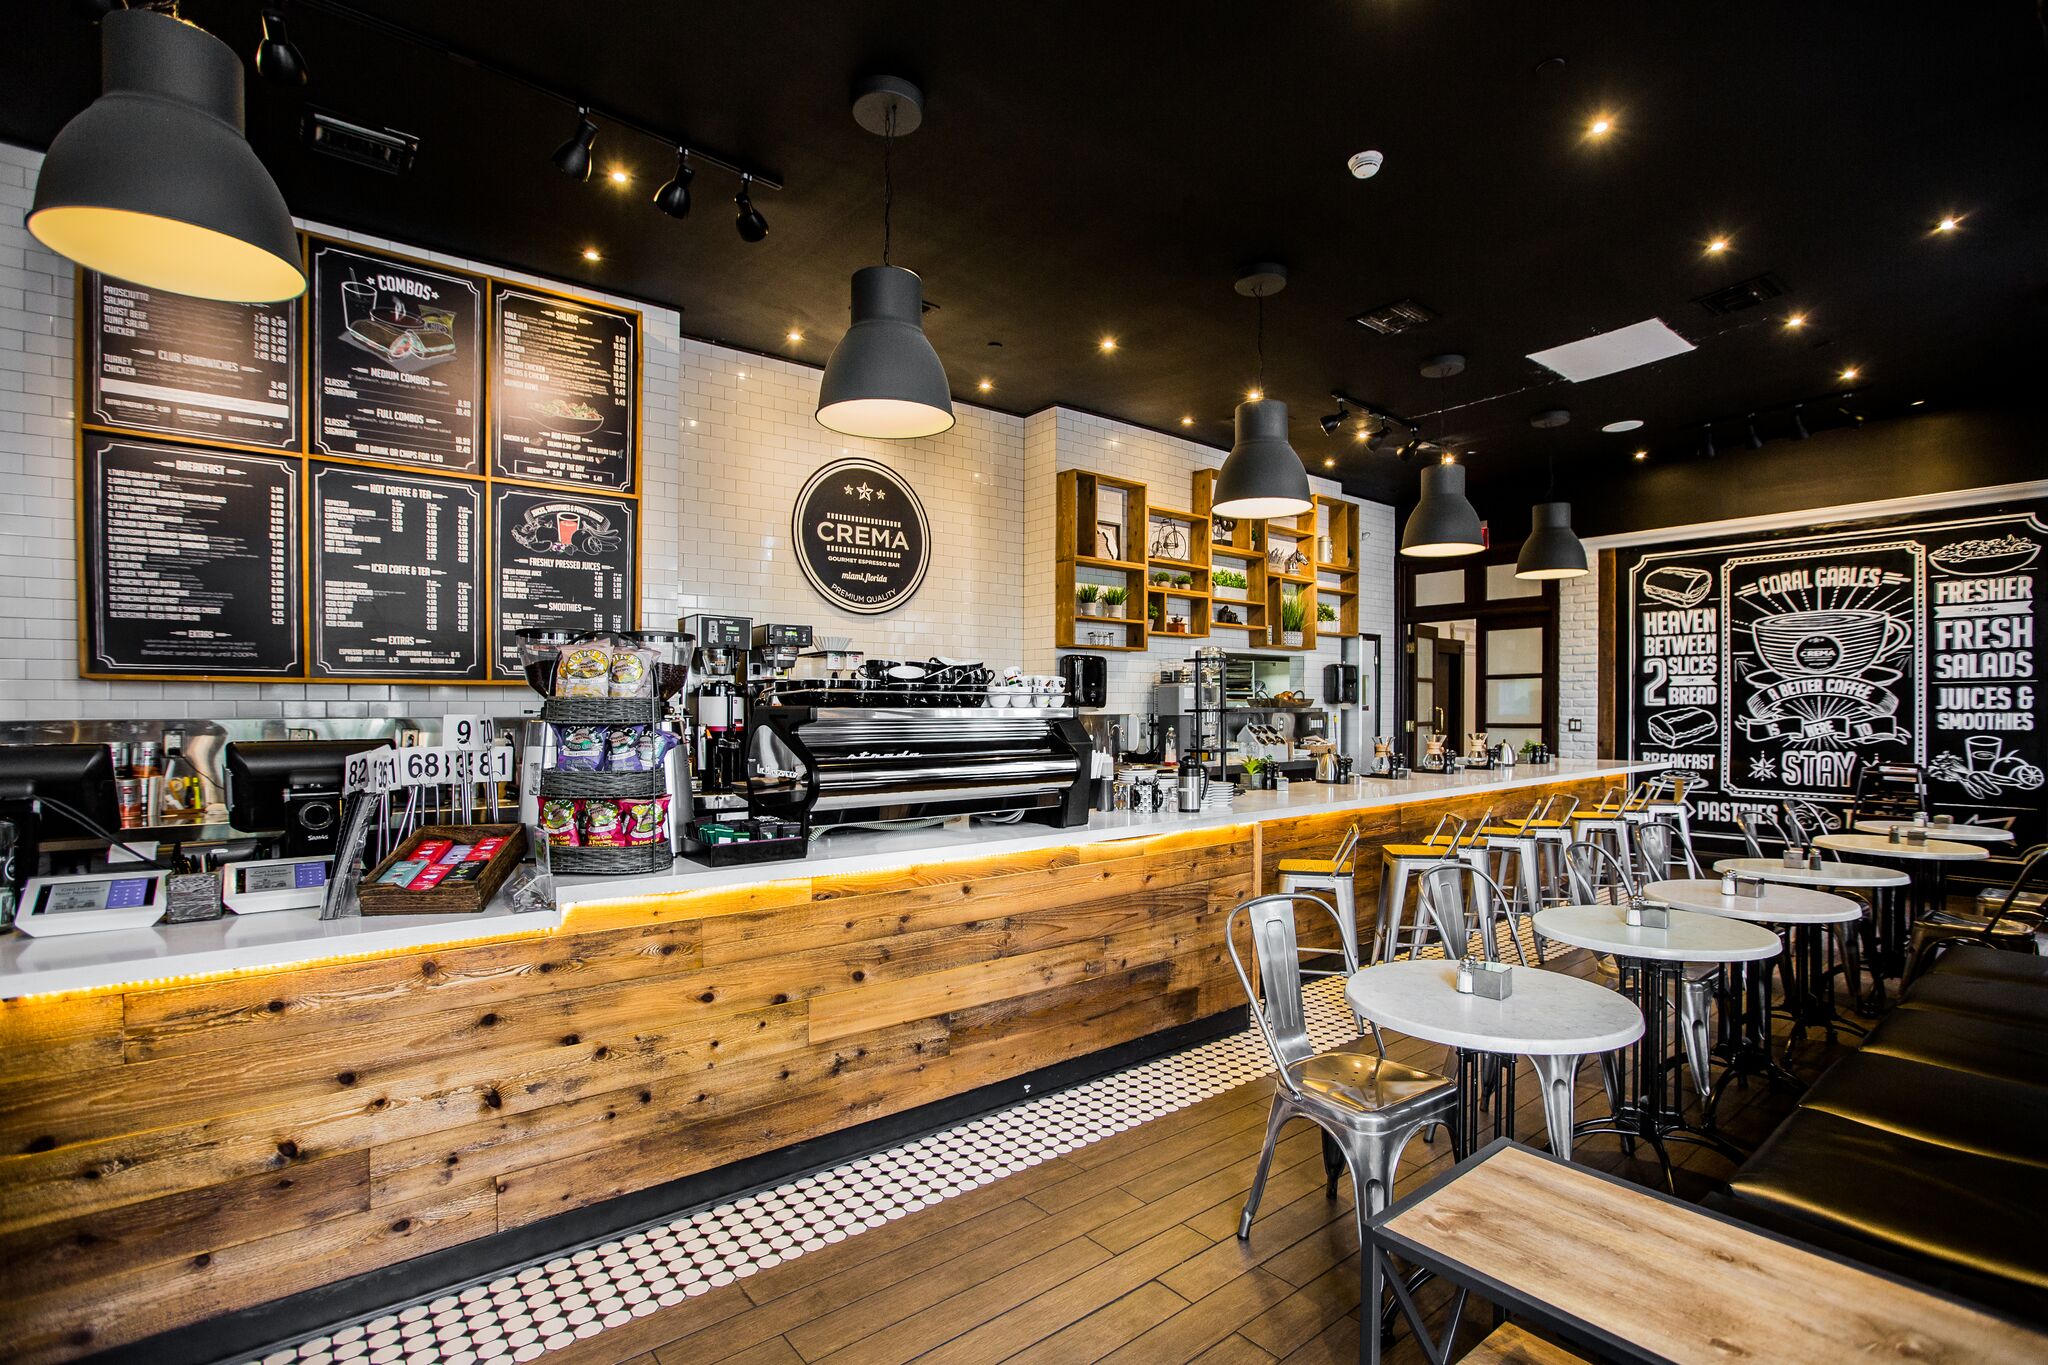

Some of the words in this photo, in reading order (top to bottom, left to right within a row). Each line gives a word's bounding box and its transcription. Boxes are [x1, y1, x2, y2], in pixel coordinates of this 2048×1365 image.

[377, 275, 432, 300] COMBOS
[556, 312, 579, 324] SALADS
[400, 372, 430, 386] COMBOS
[376, 408, 394, 419] FULL
[394, 411, 424, 424] COMBOS
[400, 449, 418, 459] CHIPS
[418, 452, 430, 461] FOR
[370, 484, 385, 494] HOT
[386, 485, 411, 497] COFFEE
[412, 488, 418, 497] &
[817, 521, 909, 550] CREMA
[371, 564, 388, 574] ICED
[389, 564, 410, 575] COFFE
[411, 566, 417, 575] &
[529, 557, 554, 567] FRESHLY
[555, 559, 580, 569] PRESSED
[581, 561, 601, 571] JUICES
[828, 555, 857, 565] GOURMET
[858, 558, 887, 567] ESPRESSO
[842, 572, 864, 582] miami,
[864, 572, 888, 583] florida
[1758, 570, 1814, 596] CORAL
[1814, 566, 1882, 588] GABLES
[832, 583, 865, 602] PREMIUM
[866, 588, 897, 603] QUALITY
[1934, 575, 2033, 604] FRESHER
[549, 602, 582, 612] SMOOTHIES
[1643, 608, 1717, 635] HEAVEN
[389, 635, 415, 646] EXTRAS
[1934, 616, 2033, 650] FRESH
[1643, 634, 1717, 656] BETWEEN
[1668, 656, 1717, 675] SLICES
[1934, 650, 2033, 679] SALADS
[1643, 657, 1667, 706] 2
[1768, 686, 1779, 701] A
[1778, 678, 1824, 697] BETTER
[1825, 678, 1875, 700] COFFEE
[1668, 686, 1717, 705] BREAD
[1935, 686, 2012, 710] JUICES
[2017, 685, 2035, 710] &
[457, 720, 471, 743] 9
[1766, 723, 1780, 737] IS
[1804, 721, 1836, 738] HERE
[1853, 723, 1873, 737] TO
[1936, 712, 2034, 731] SMOOTHIES
[349, 758, 368, 786] 82
[408, 753, 439, 778] 68
[480, 752, 506, 776] 81
[1781, 750, 1857, 787] STAY
